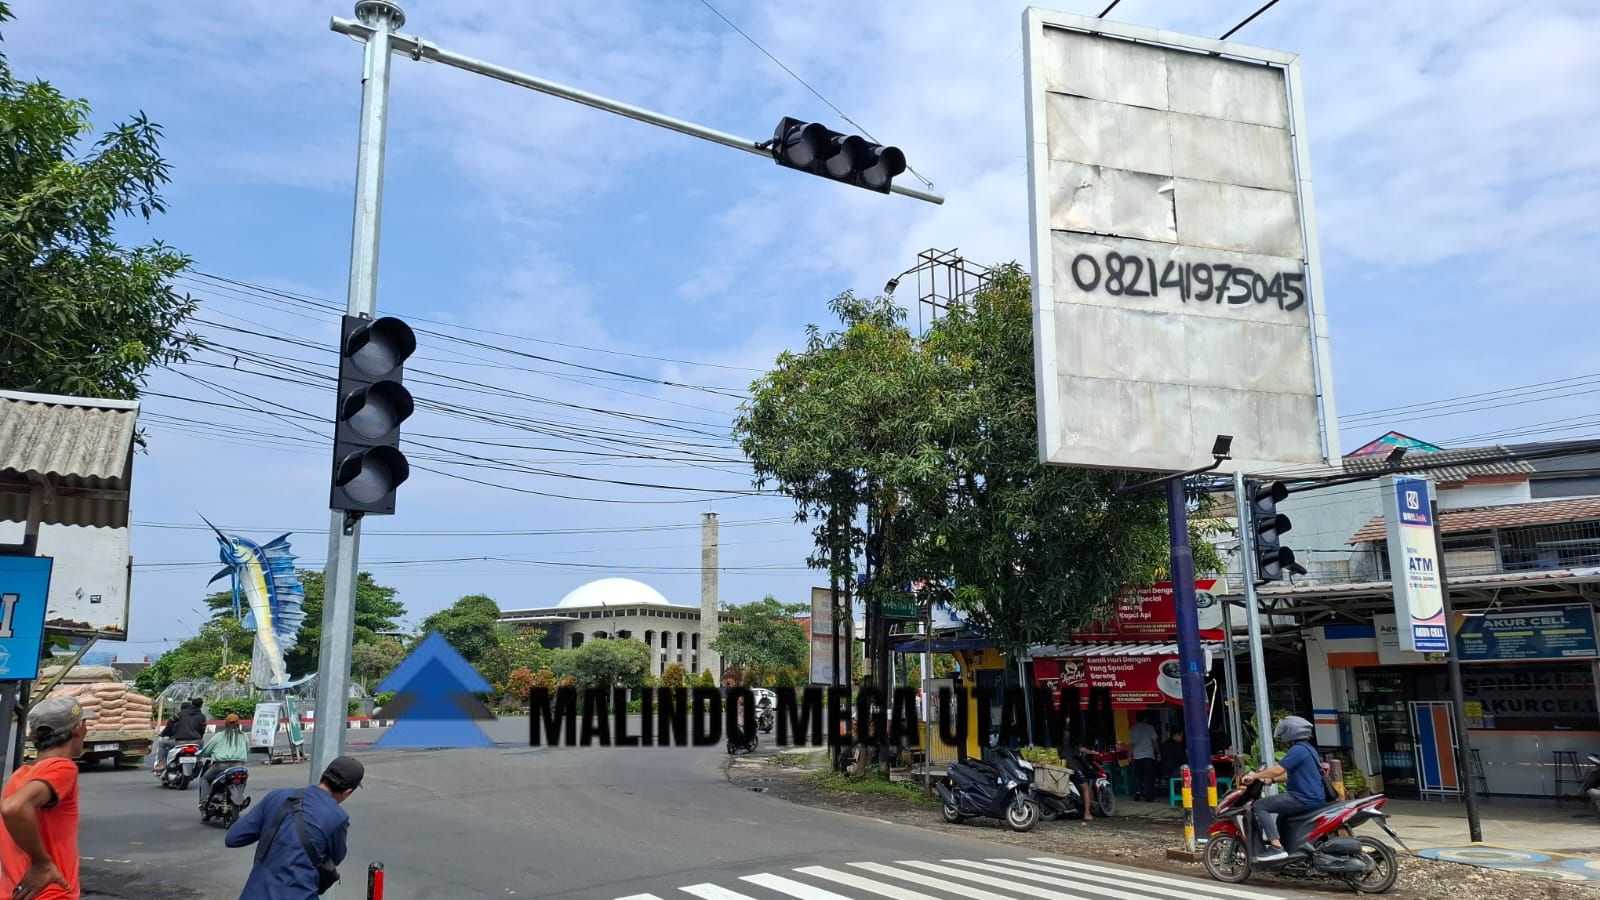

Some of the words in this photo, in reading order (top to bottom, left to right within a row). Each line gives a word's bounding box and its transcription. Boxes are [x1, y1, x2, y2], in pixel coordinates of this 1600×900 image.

[1072, 251, 1304, 310] 082141975045
[1409, 556, 1433, 571] ATM
[1482, 618, 1526, 628] AKUR
[1530, 616, 1570, 625] CELL
[1122, 656, 1151, 664] Dengan
[1089, 664, 1107, 672] Yang
[1114, 680, 1126, 688] Api
